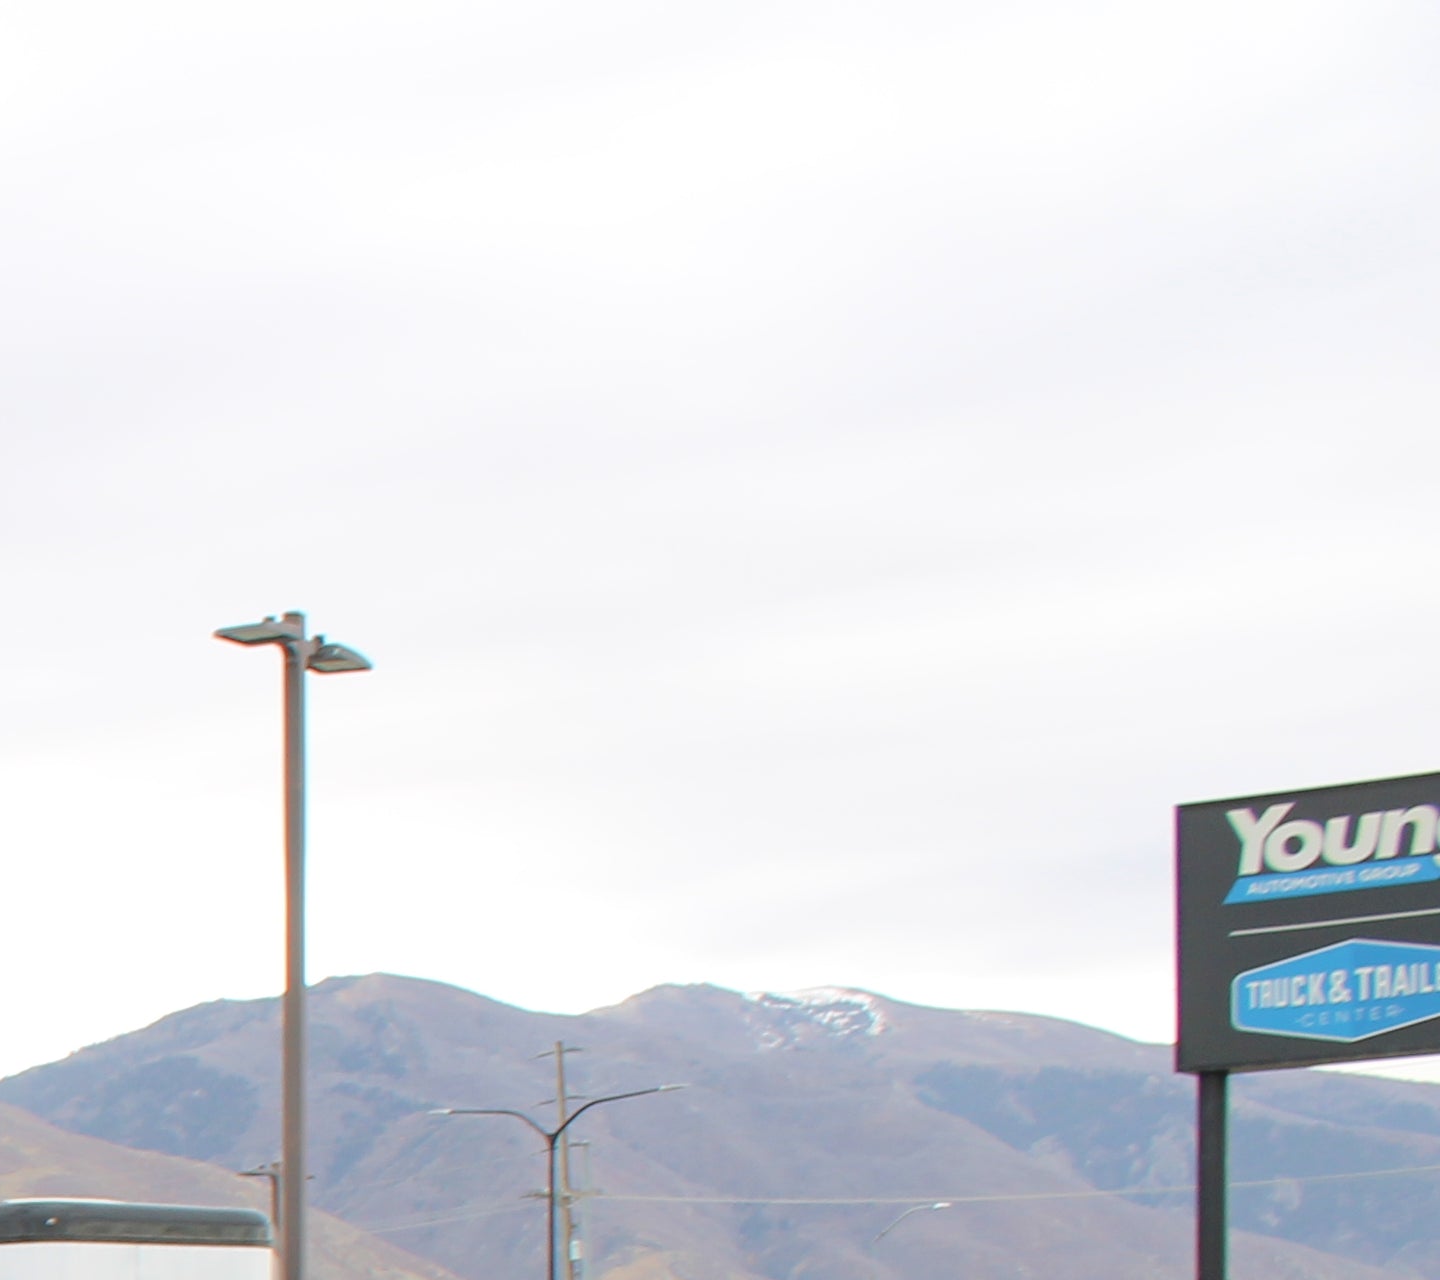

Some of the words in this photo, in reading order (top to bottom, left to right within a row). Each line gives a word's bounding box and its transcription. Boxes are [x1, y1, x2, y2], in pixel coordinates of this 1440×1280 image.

[1225, 802, 1440, 877] Youn
[1246, 869, 1356, 895] AUTOMOTIVE
[1358, 862, 1421, 881] GROUP
[1246, 973, 1327, 1009] TRUCK
[1329, 969, 1351, 1003] &
